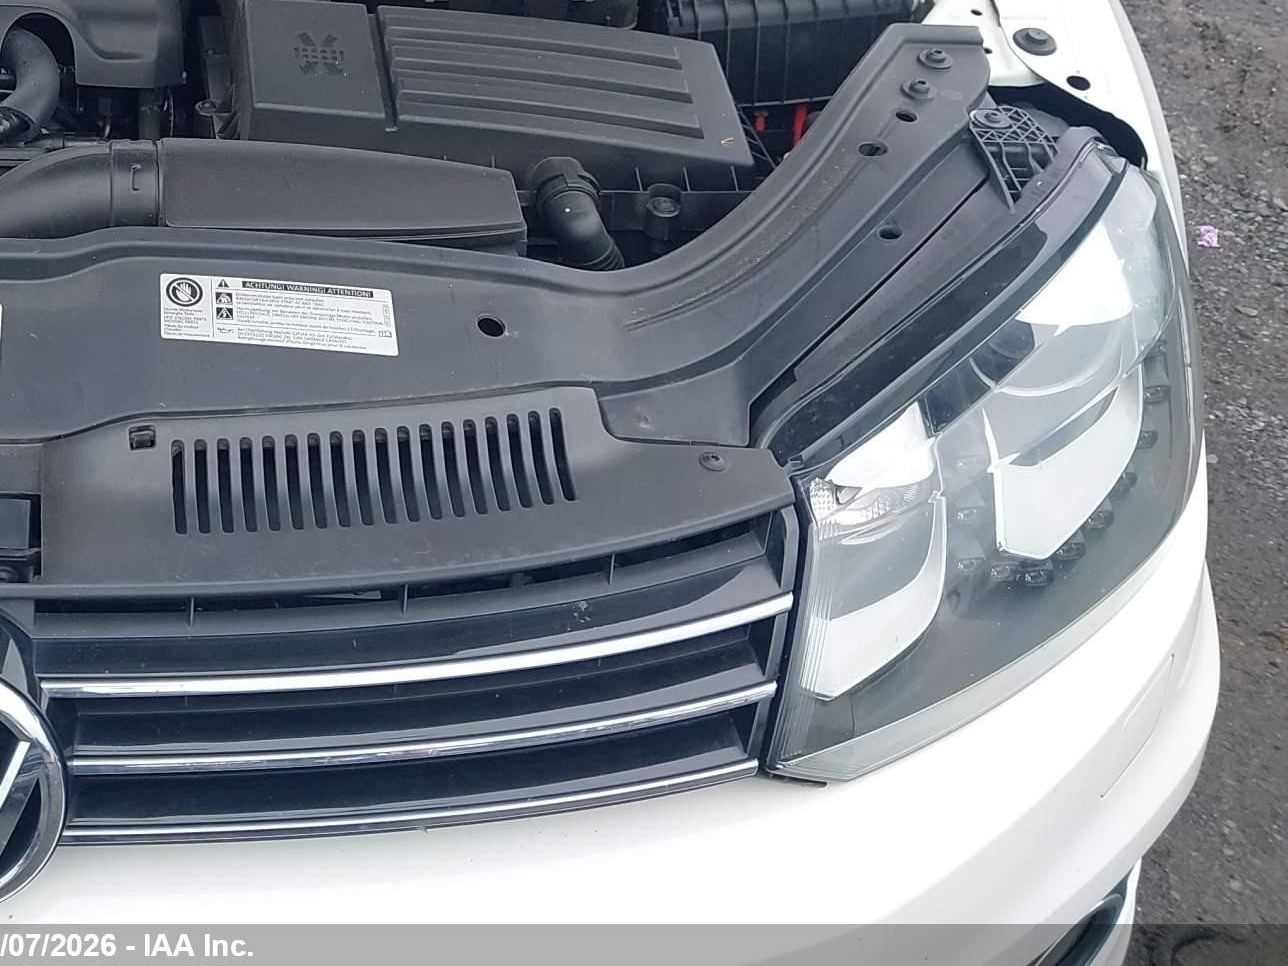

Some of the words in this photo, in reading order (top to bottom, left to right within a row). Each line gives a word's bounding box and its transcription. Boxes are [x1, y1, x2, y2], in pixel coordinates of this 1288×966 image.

[245, 281, 284, 290] ACHTUNG!
[286, 284, 325, 294] WARNING!
[327, 287, 372, 298] ATTENTION!
